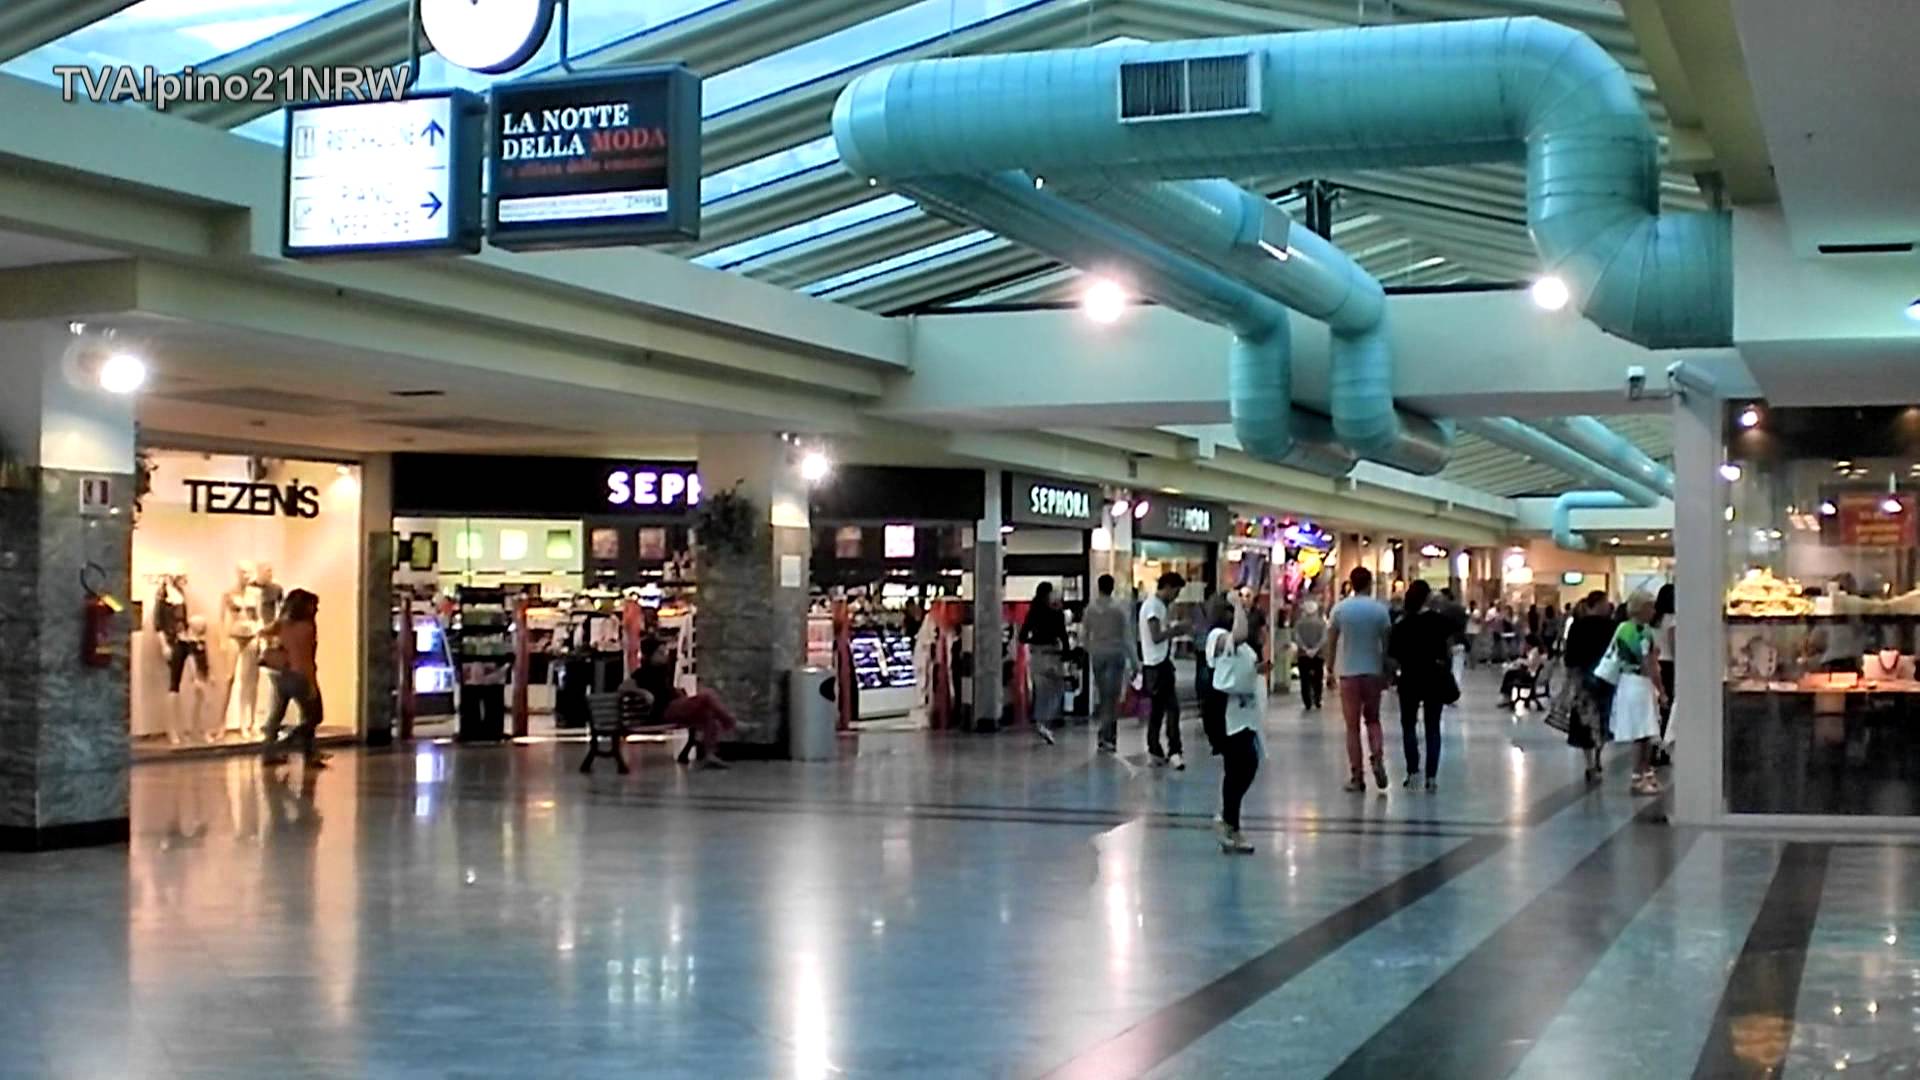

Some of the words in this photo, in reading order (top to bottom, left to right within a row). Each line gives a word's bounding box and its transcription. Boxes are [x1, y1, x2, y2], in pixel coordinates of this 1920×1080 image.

[503, 112, 535, 135] LA
[542, 104, 630, 132] NOTTE
[502, 133, 585, 160] DELLA
[591, 128, 665, 151] MODA
[1031, 486, 1090, 518] SEPHORA
